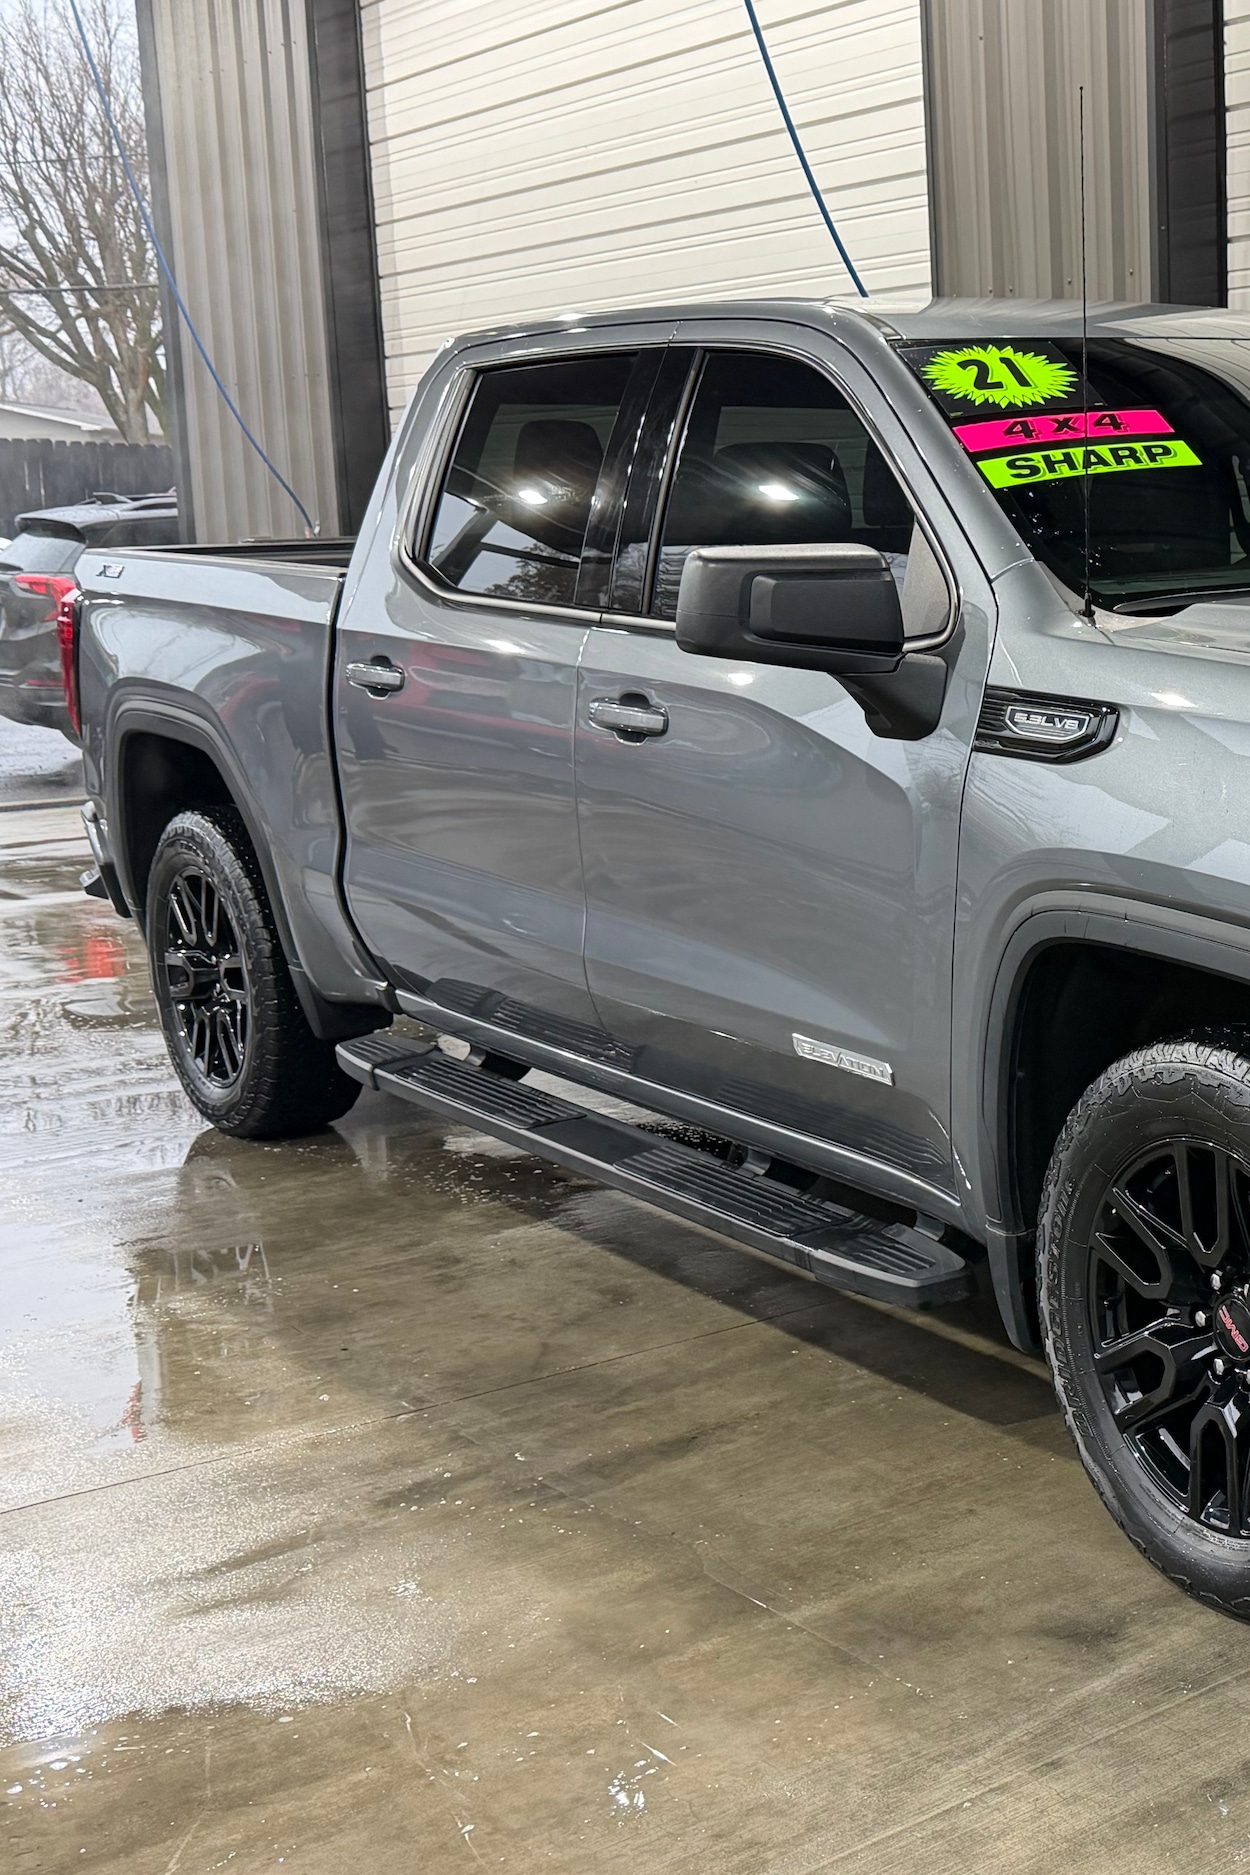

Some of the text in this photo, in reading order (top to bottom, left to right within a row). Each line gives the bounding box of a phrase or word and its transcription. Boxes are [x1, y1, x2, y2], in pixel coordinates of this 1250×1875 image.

[956, 356, 1036, 391] 21
[1006, 444, 1176, 479] SHARP
[801, 1041, 884, 1079] ELEVATION
[1218, 1304, 1249, 1353] GMC
